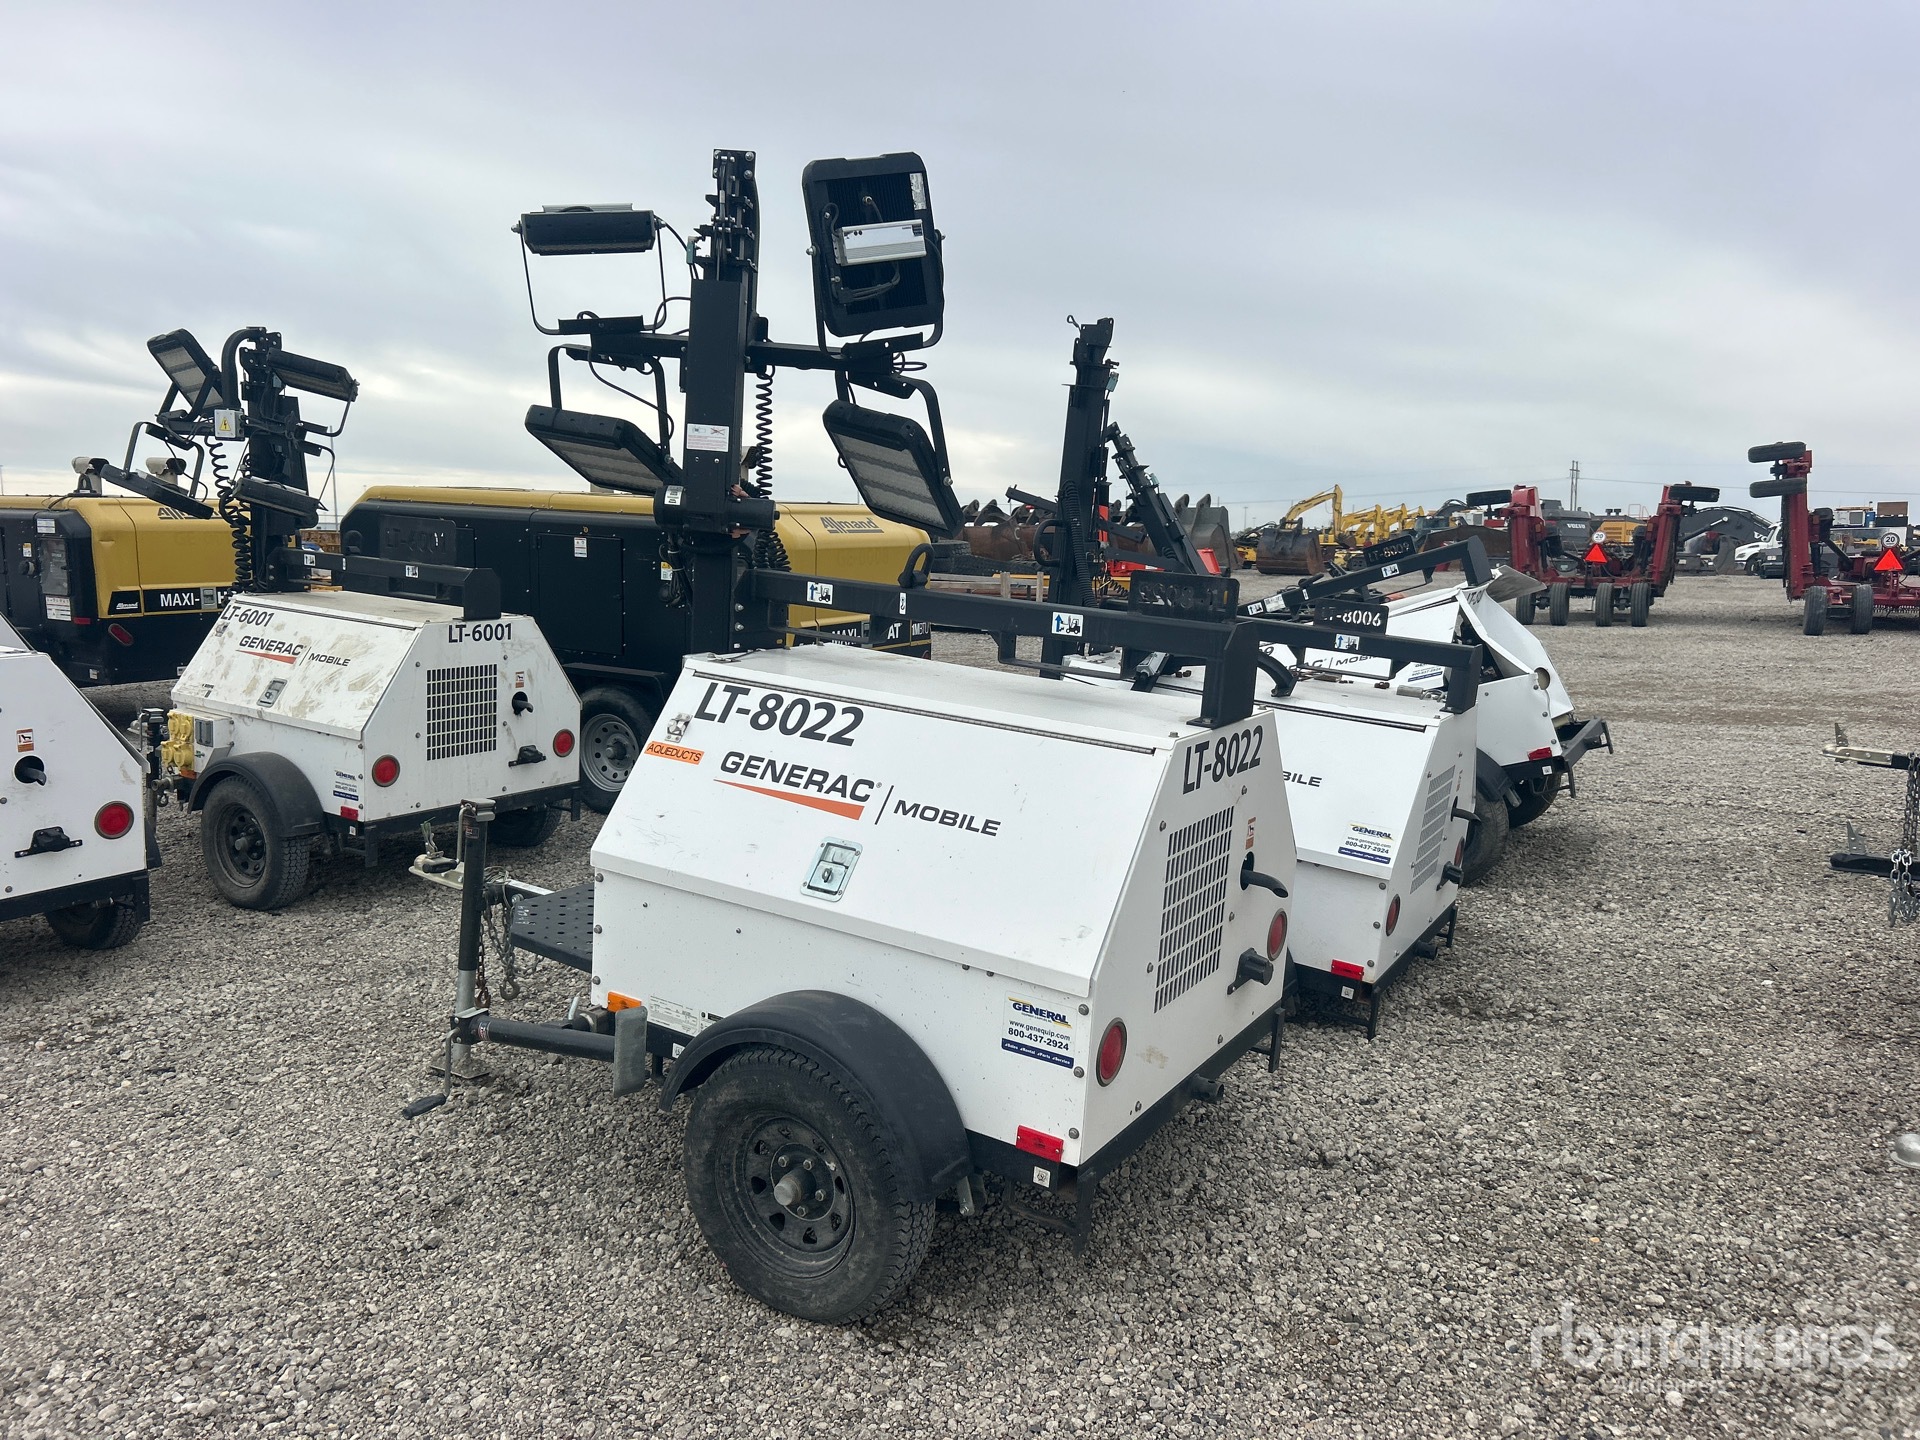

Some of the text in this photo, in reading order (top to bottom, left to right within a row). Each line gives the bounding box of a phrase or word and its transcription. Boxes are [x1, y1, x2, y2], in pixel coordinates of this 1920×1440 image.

[820, 516, 881, 533] Allmand
[160, 593, 200, 607] MAXI-
[220, 604, 275, 627] LT-6001
[448, 623, 512, 643] LT-6001
[887, 623, 903, 640] AT
[239, 635, 351, 667] GENERAC MOBILE
[694, 682, 865, 747] LT-8022
[646, 743, 702, 764] AQUEDUCTS
[1182, 725, 1263, 795] LT-8022
[1282, 770, 1323, 788] BILE
[720, 751, 1002, 838] GENERAC MOBILE
[1351, 826, 1392, 839] GENERAL
[1344, 840, 1390, 854] 800-437-2924
[1012, 1002, 1069, 1024] GENERAL
[1007, 1027, 1070, 1051] 800-437-2924
[1008, 1020, 1071, 1041] www.genequip.com
